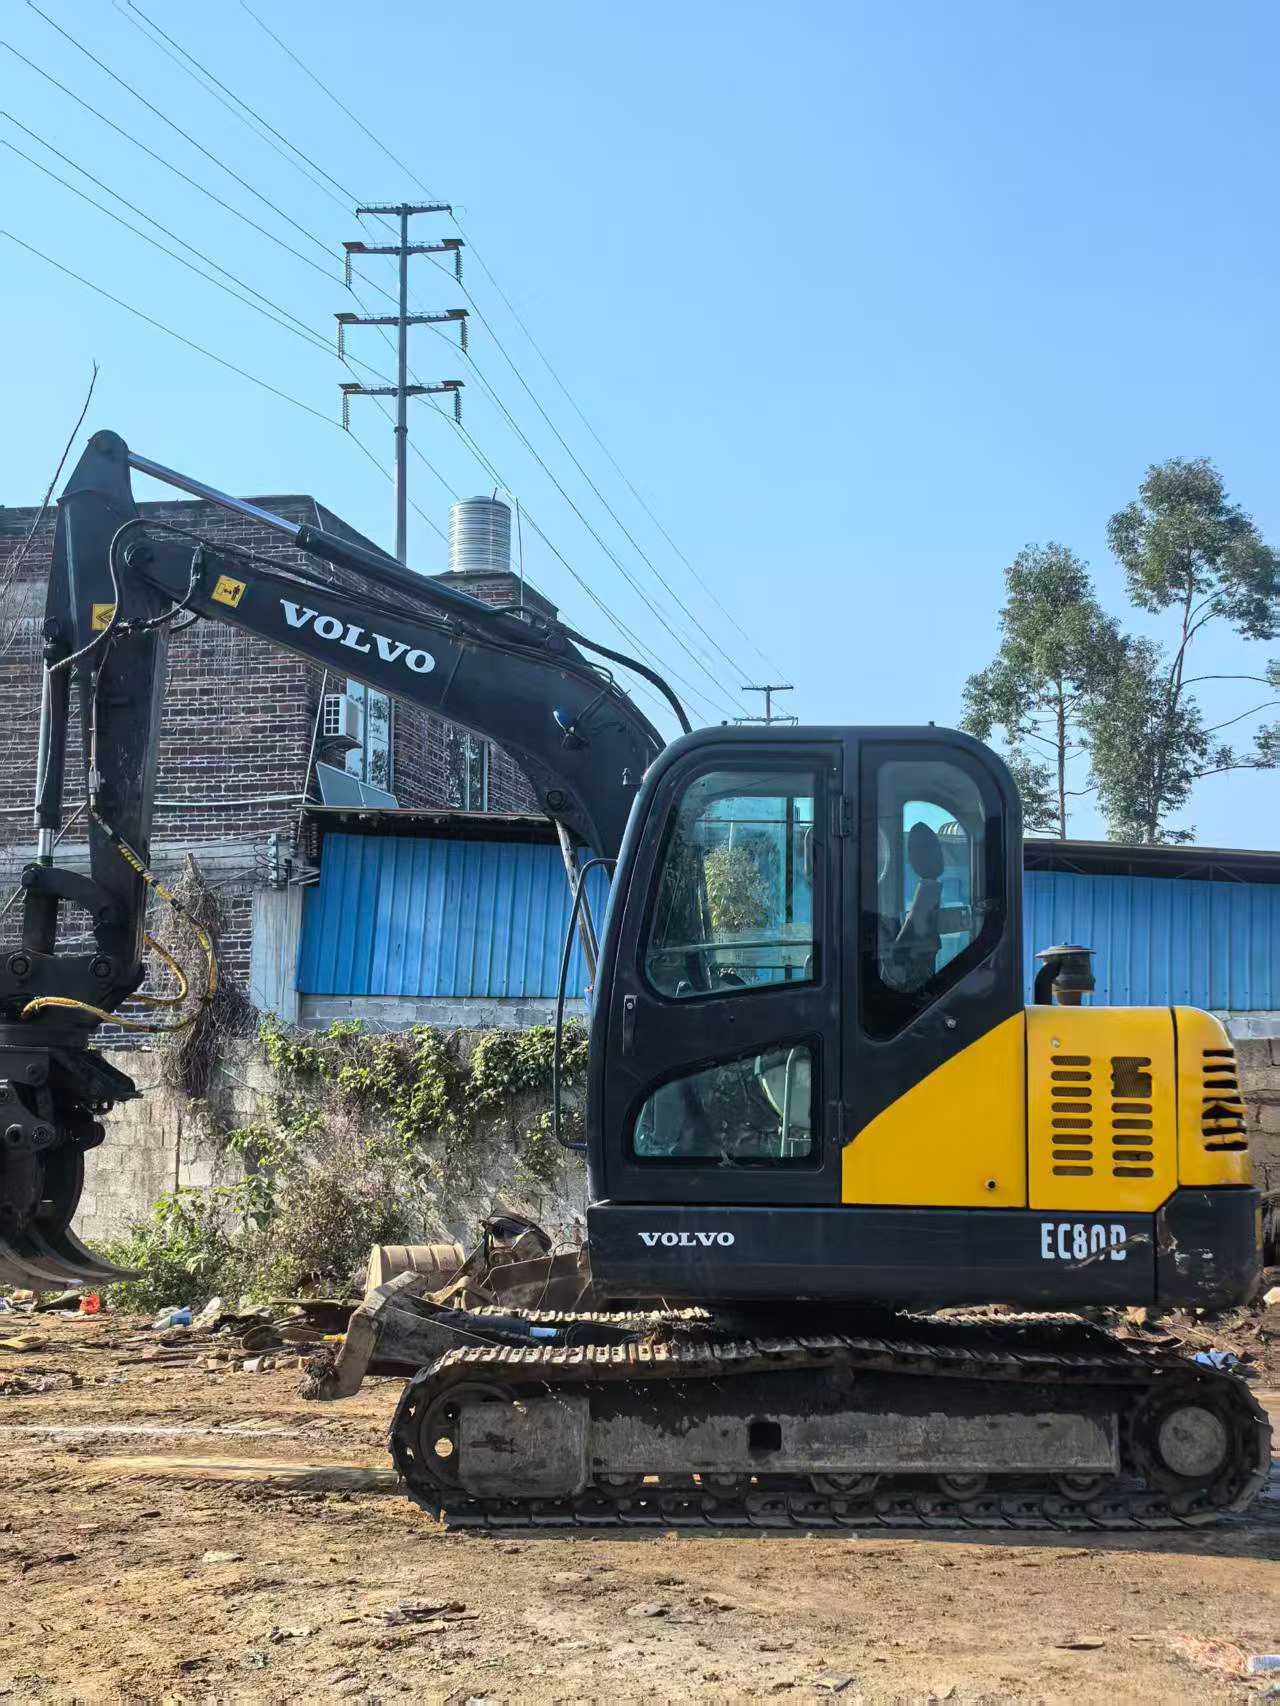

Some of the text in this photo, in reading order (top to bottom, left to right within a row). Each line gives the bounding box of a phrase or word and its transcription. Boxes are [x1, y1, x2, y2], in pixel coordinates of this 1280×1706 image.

[279, 598, 436, 674] VOLVO
[638, 1232, 735, 1247] VOLVO
[1040, 1222, 1127, 1261] EC80D
